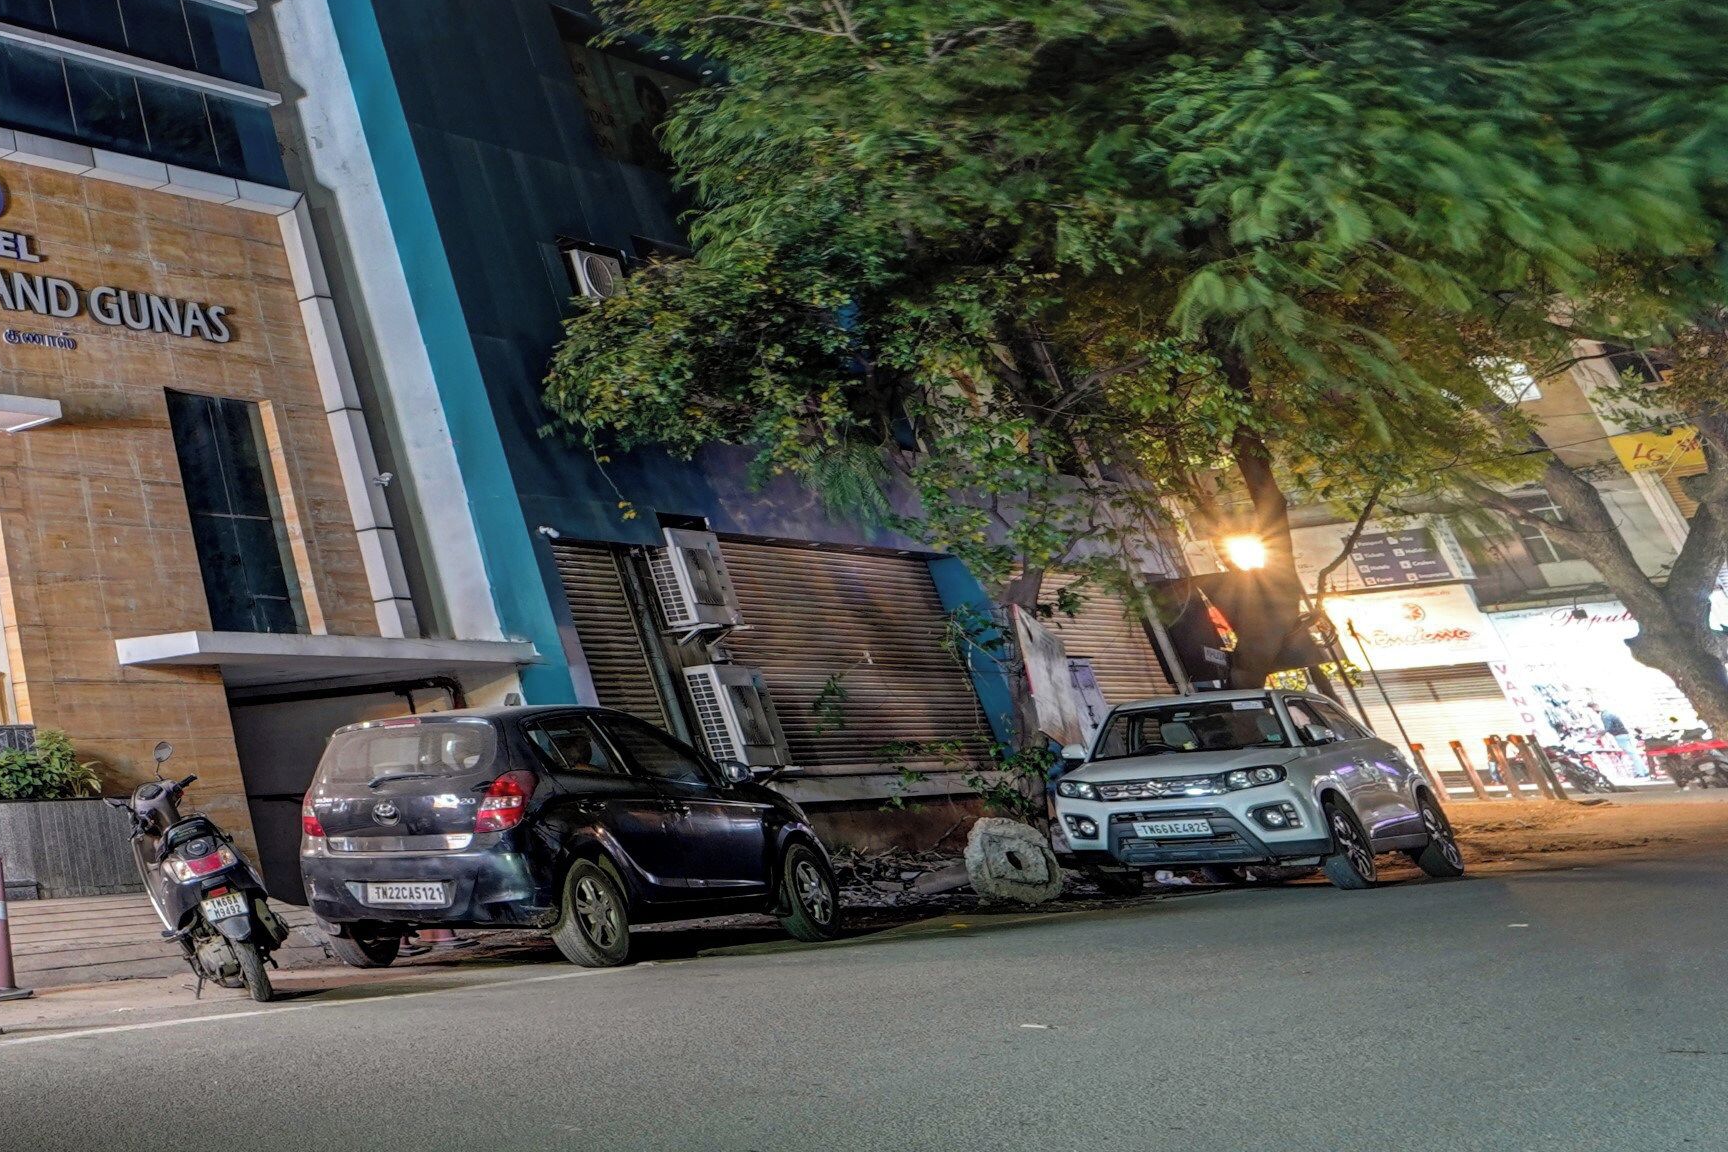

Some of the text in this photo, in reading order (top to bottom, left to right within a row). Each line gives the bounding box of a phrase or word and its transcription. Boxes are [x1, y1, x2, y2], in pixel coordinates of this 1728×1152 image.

[87, 286, 231, 343] GUNAS
[3, 328, 77, 350] குணாஸ்
[1141, 822, 1210, 835] TN66AE4825
[212, 892, 239, 908] TN66A
[375, 885, 443, 901] TN22CA5121
[214, 904, 242, 919] M9492
